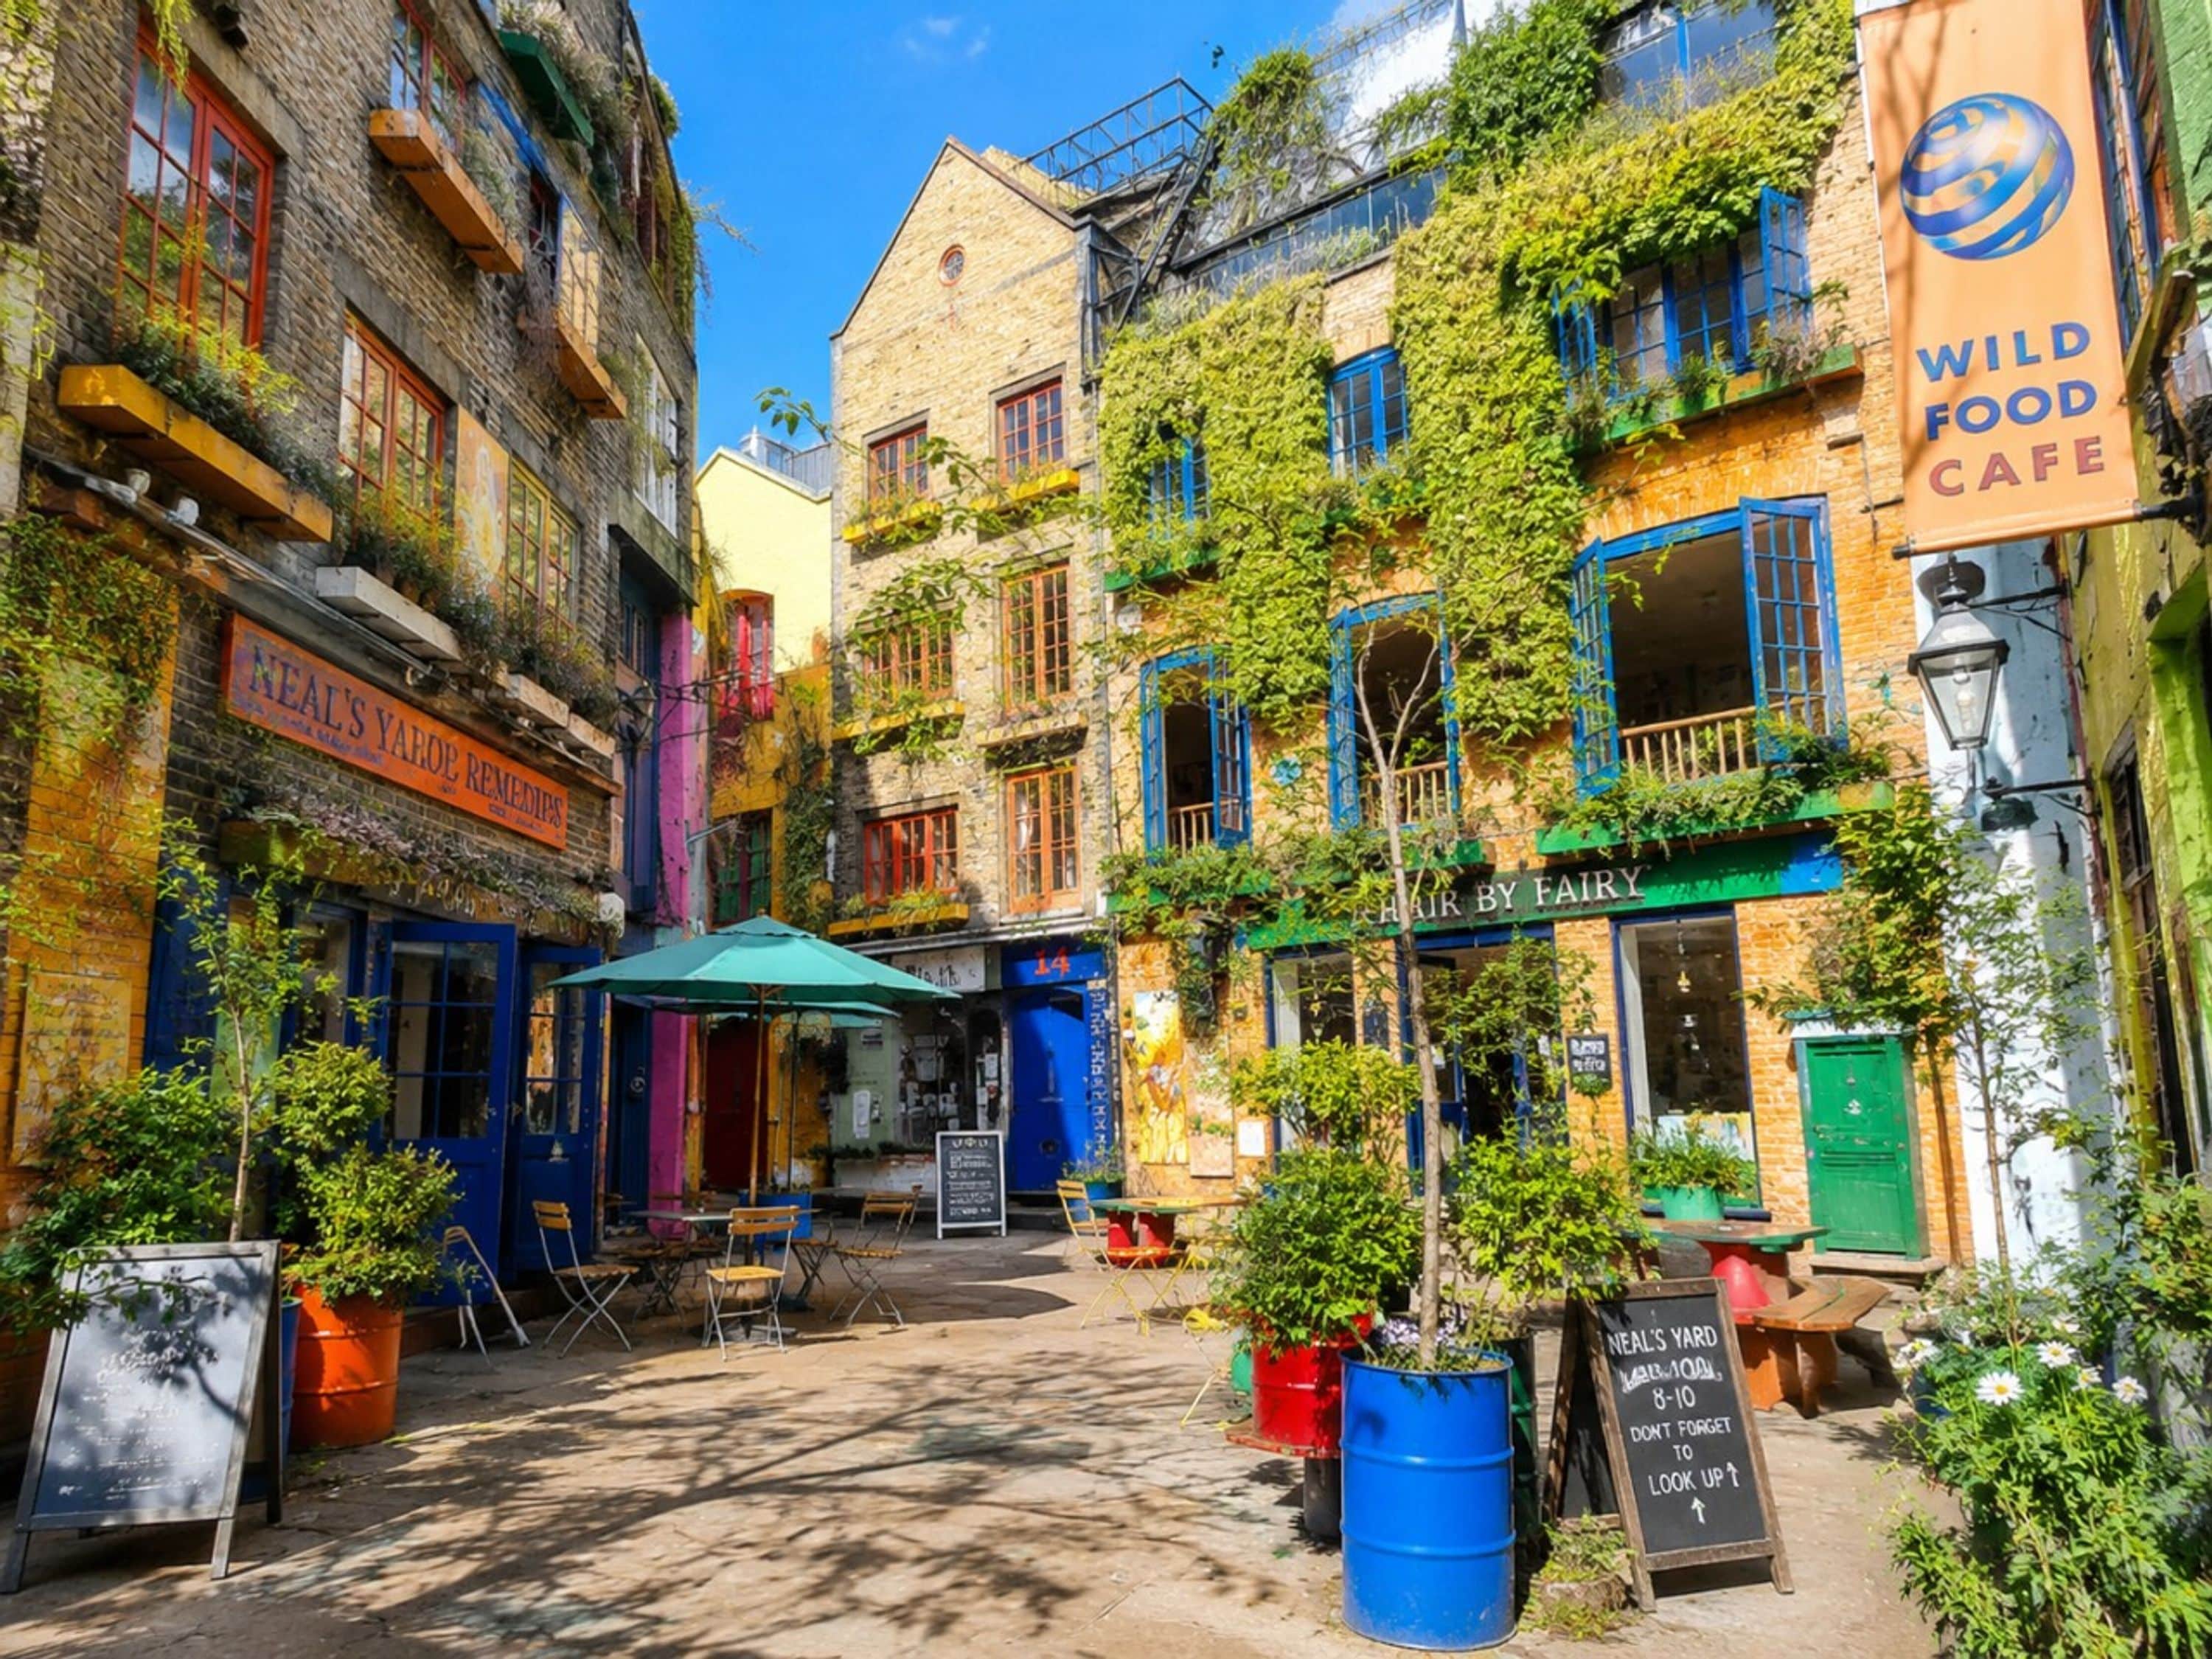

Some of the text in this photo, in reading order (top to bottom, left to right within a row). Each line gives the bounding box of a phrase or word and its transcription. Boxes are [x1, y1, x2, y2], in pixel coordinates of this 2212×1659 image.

[1916, 321, 2091, 383] WILD
[1924, 379, 2098, 442] FOOD
[1928, 435, 2105, 497] CAFE
[249, 645, 366, 740] NEAL'S
[1477, 881, 1518, 914] BY
[1534, 866, 1645, 906] FAIRY
[1034, 947, 1071, 978] 14
[1607, 1325, 1718, 1356] NEAL'S YARD
[1652, 1385, 1696, 1411] 8-10
[1677, 1416, 1732, 1438] FORGET
[1672, 1444, 1694, 1461] TO
[1648, 1467, 1725, 1496] LOOK UP
